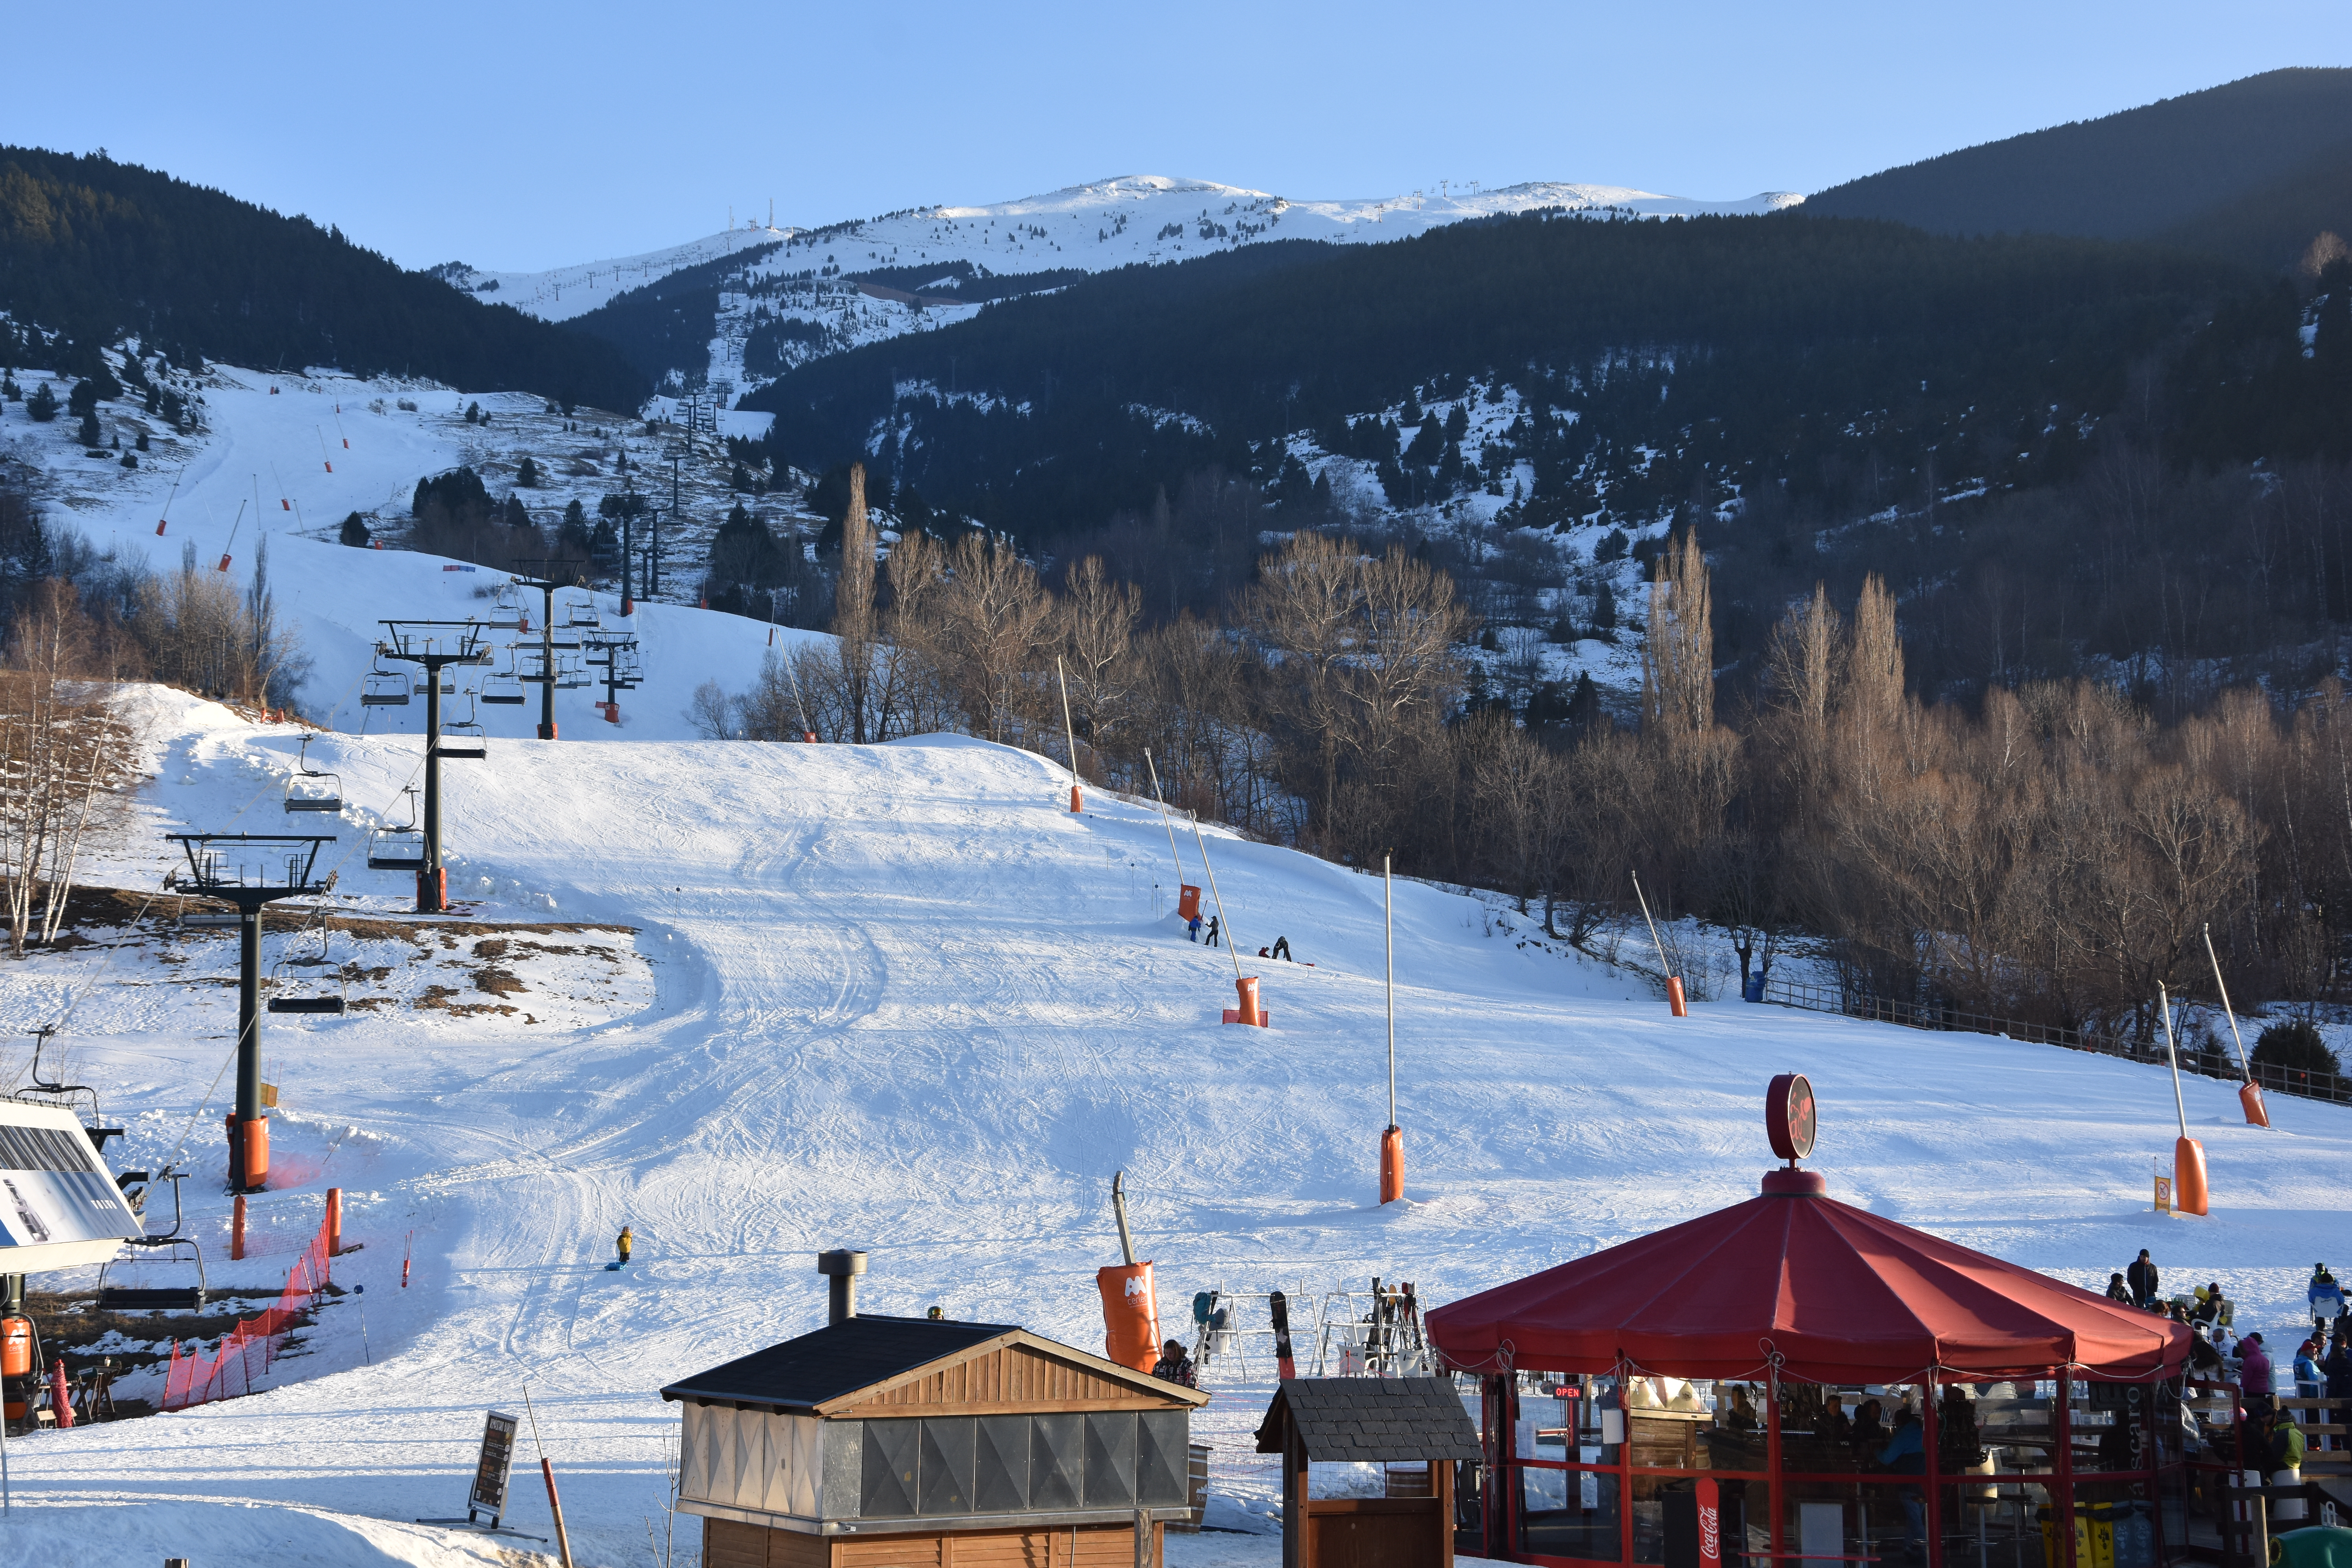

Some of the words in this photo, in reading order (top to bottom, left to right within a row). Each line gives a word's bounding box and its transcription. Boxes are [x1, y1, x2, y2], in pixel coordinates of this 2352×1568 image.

[91, 1200, 117, 1209] VOLVO
[1127, 1295, 1147, 1305] cerler
[1556, 1388, 1579, 1397] OPEN
